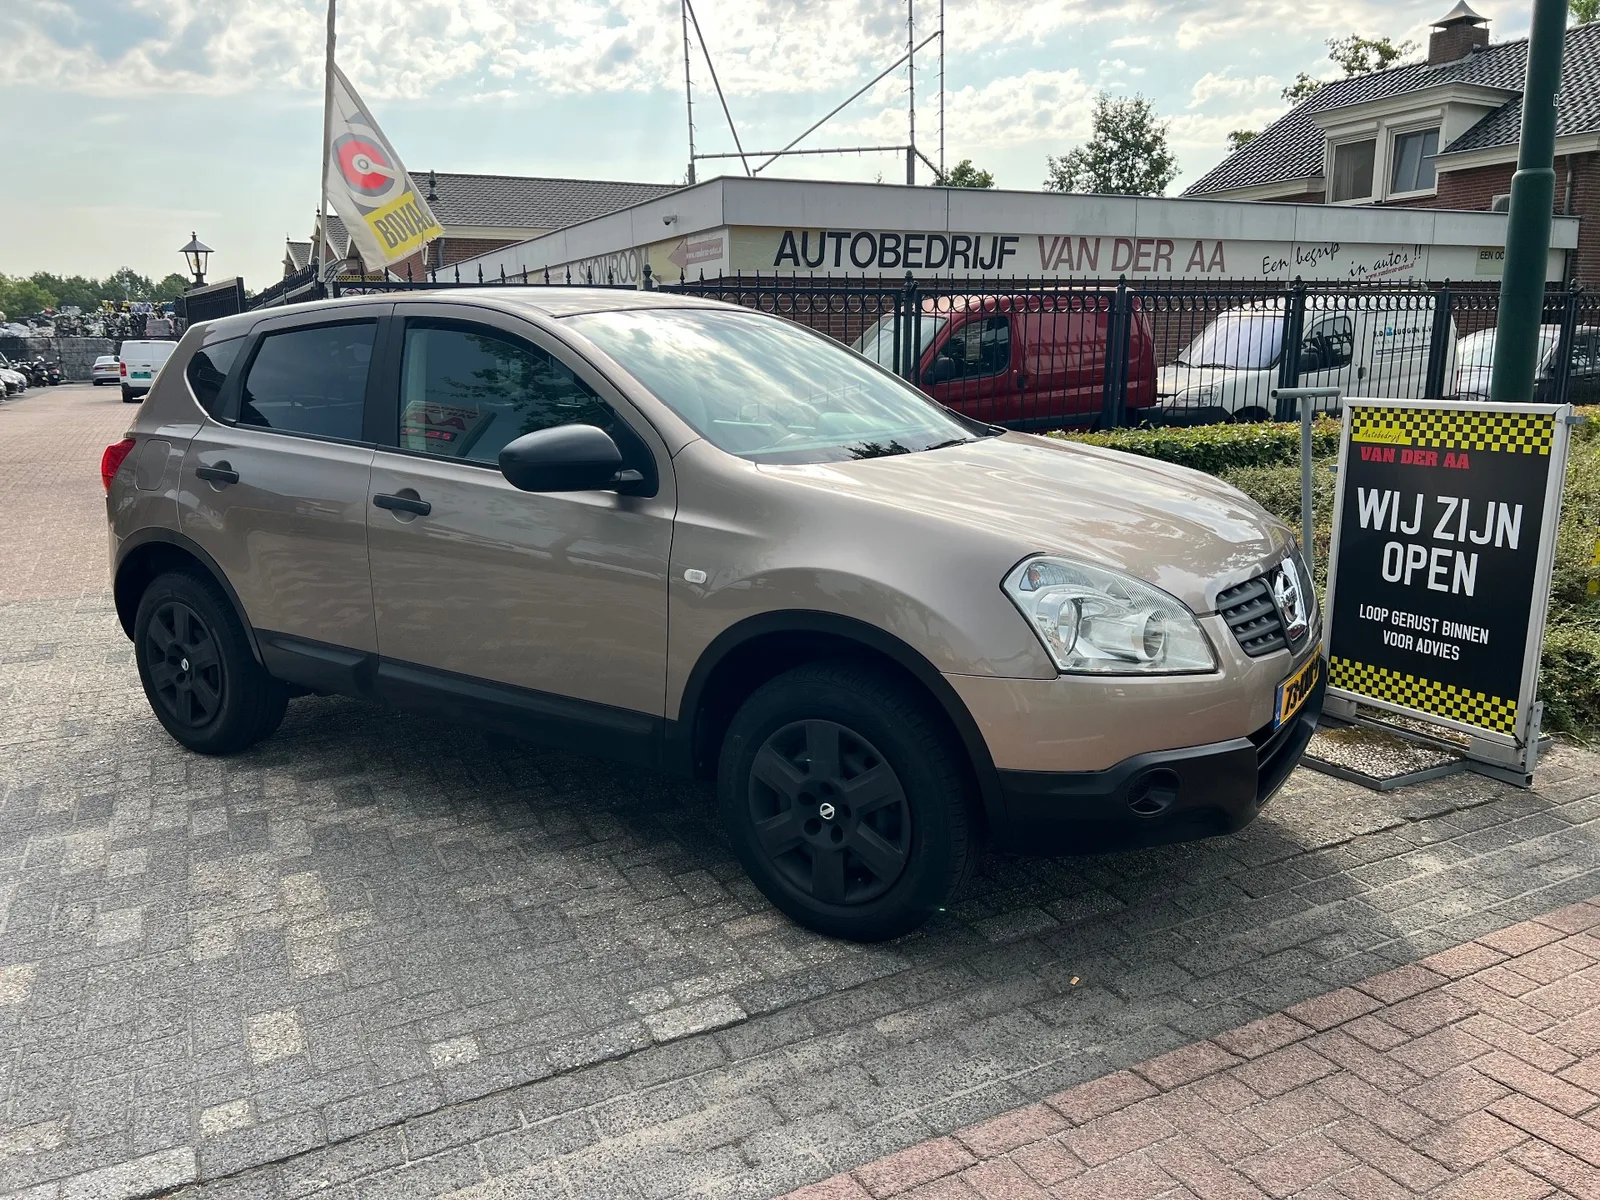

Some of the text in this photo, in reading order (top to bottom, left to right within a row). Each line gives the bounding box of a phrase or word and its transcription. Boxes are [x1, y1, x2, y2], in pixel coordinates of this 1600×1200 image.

[773, 230, 1225, 272] AUTOBEDRIJF VAN DER AA
[1262, 242, 1340, 274] Een begrip
[1480, 251, 1493, 260] EEN
[1348, 261, 1368, 277] in
[1361, 429, 1403, 443] Autobedrijf
[1360, 446, 1470, 470] VAN DER AA
[1357, 487, 1523, 550] WIJ ZIJN
[1381, 541, 1479, 597] OPEN
[1359, 603, 1489, 645] LOOP GERUST BINNEN
[1383, 629, 1460, 661] VOOR ADVIES
